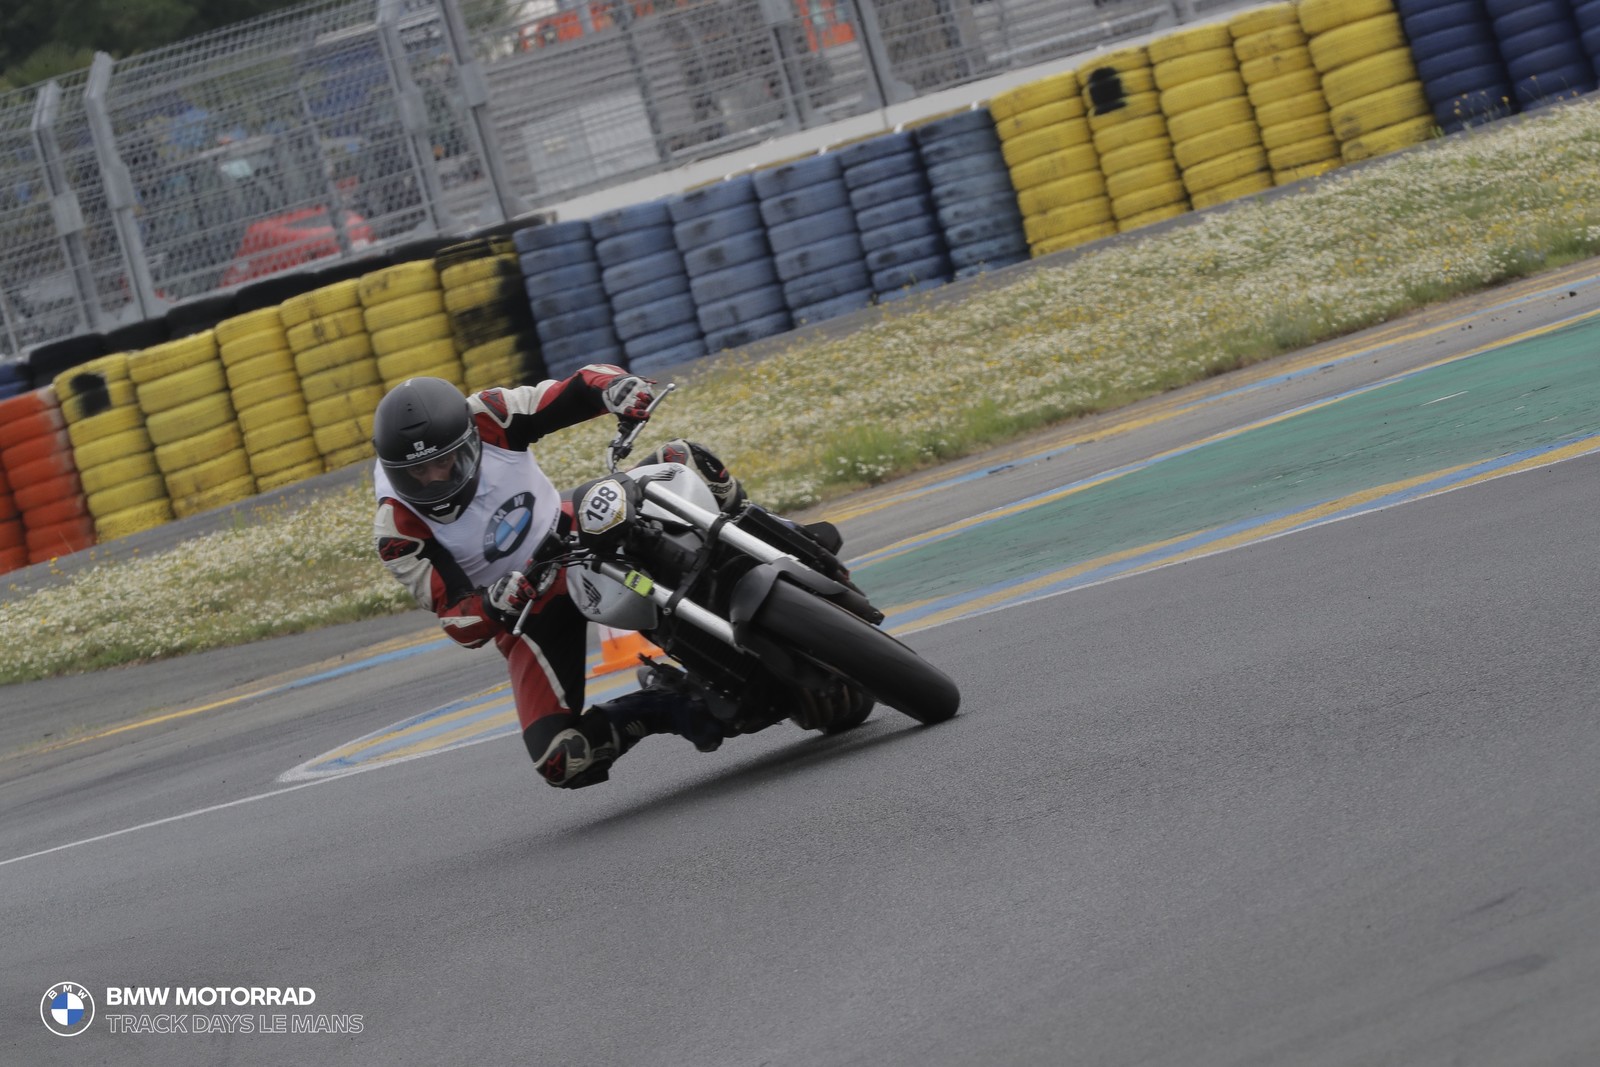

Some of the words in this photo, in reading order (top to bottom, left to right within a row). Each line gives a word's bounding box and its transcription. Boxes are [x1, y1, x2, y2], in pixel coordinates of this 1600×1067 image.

[406, 446, 438, 460] SHARK
[486, 493, 526, 545] BMW
[586, 486, 618, 522] 198
